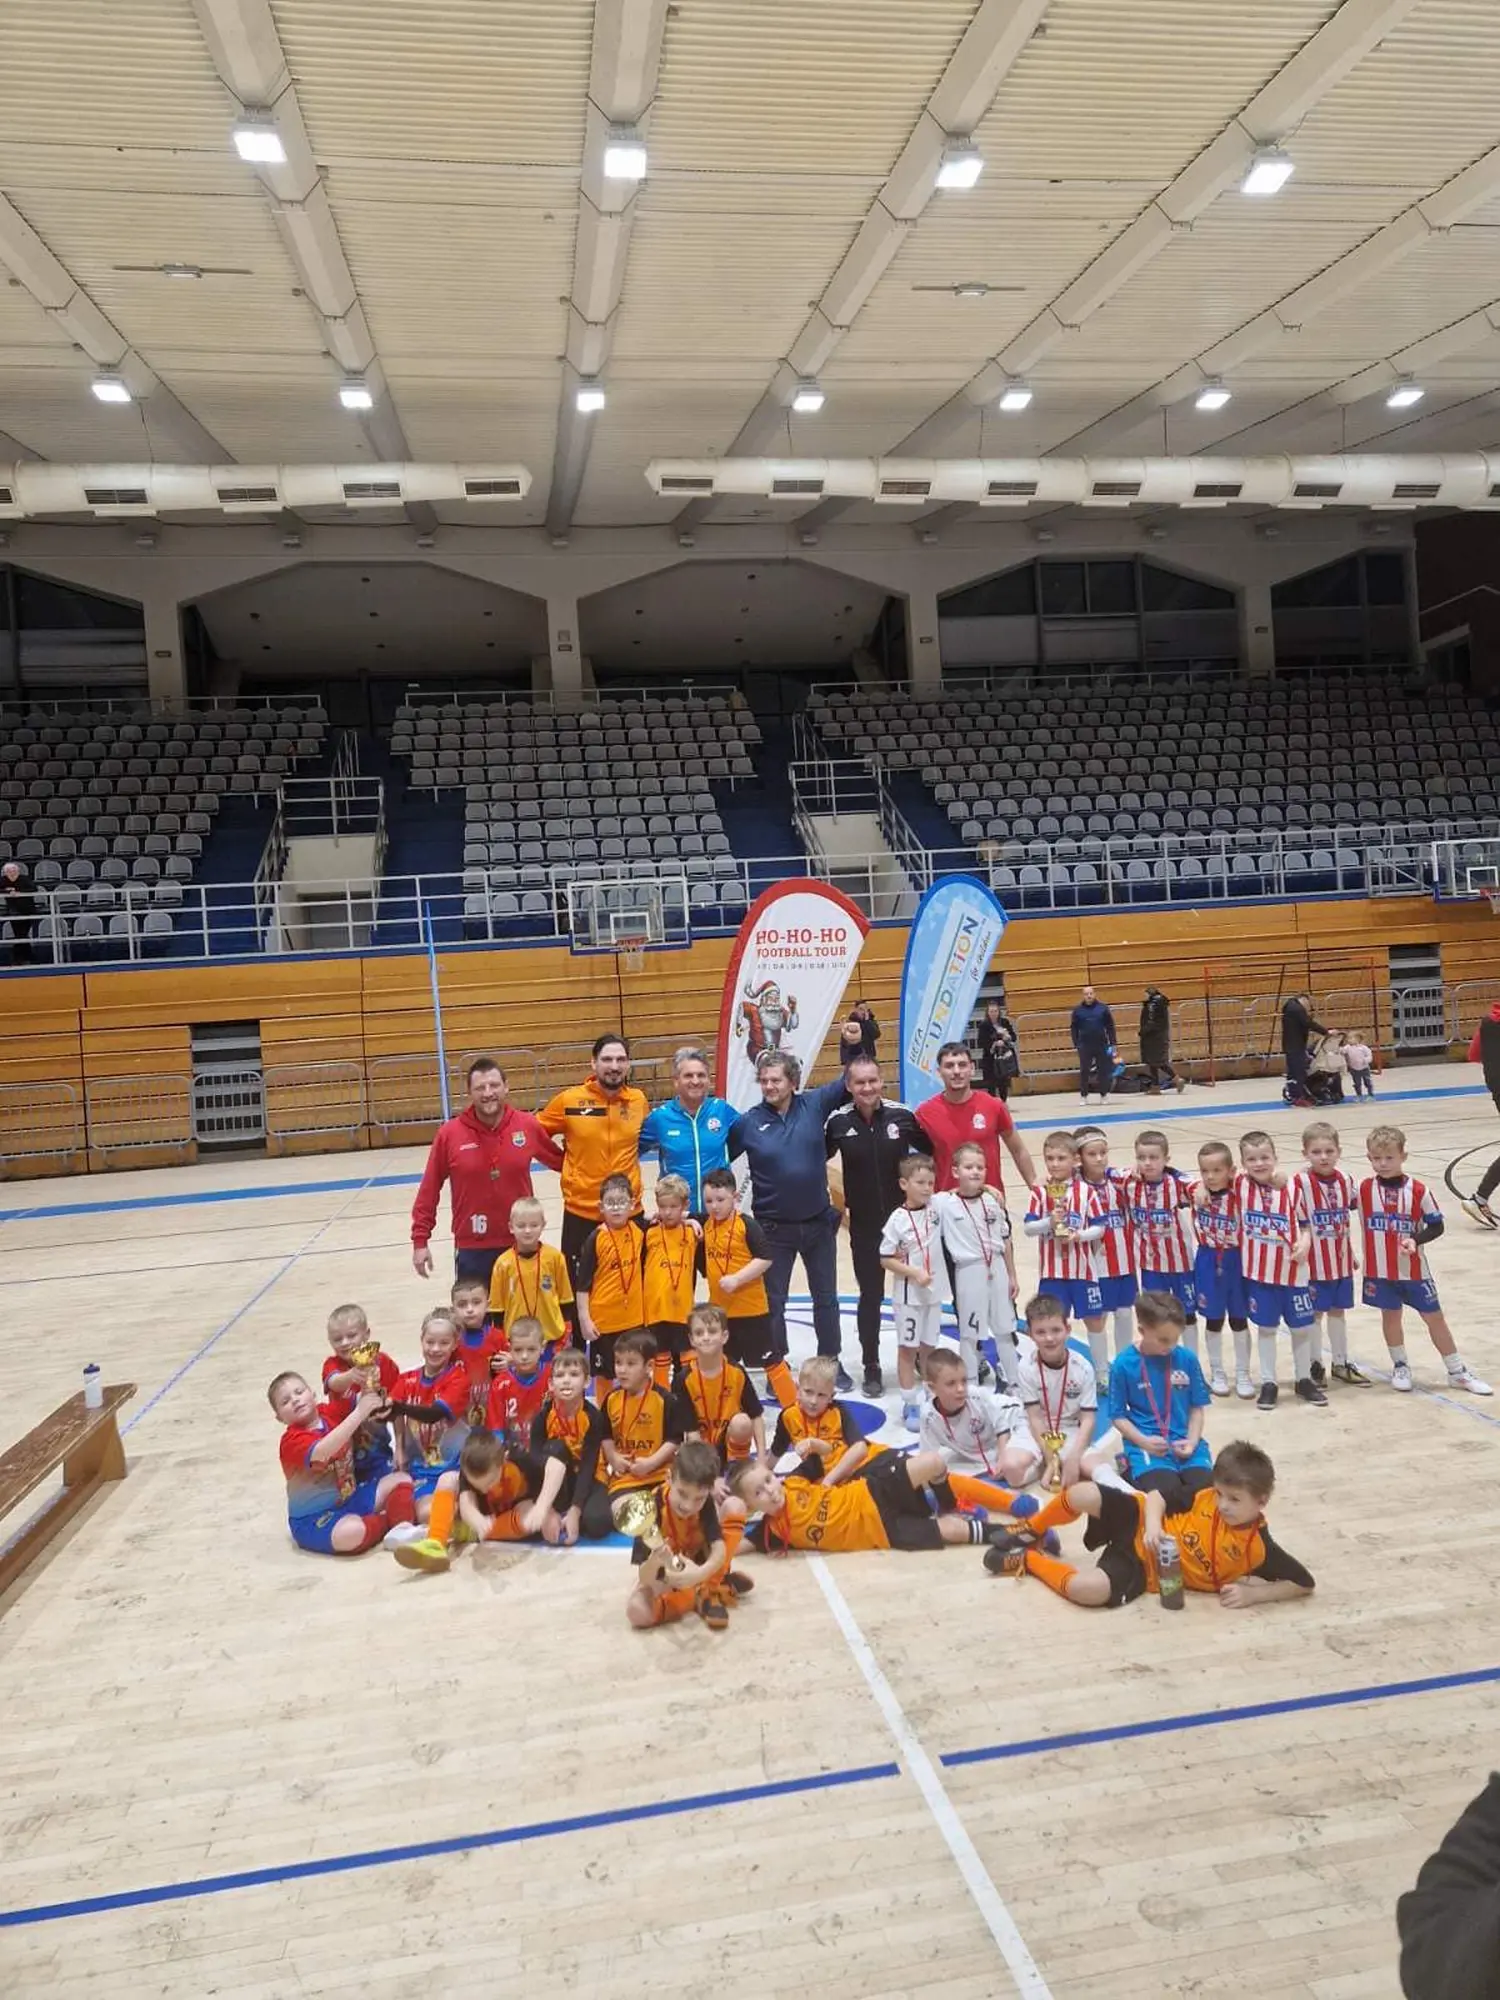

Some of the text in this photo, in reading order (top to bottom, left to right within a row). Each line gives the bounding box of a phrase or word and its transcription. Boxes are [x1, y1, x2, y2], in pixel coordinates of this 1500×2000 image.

[756, 928, 847, 944] HO-HO-HO
[757, 946, 846, 958] FOOTBALL TOUR
[910, 1028, 923, 1062] UEFA
[470, 1214, 488, 1234] 16
[1293, 1293, 1313, 1312] 20
[904, 1317, 916, 1341] 3
[968, 1311, 979, 1334] 4
[595, 1353, 603, 1367] 3
[505, 1398, 518, 1417] 12
